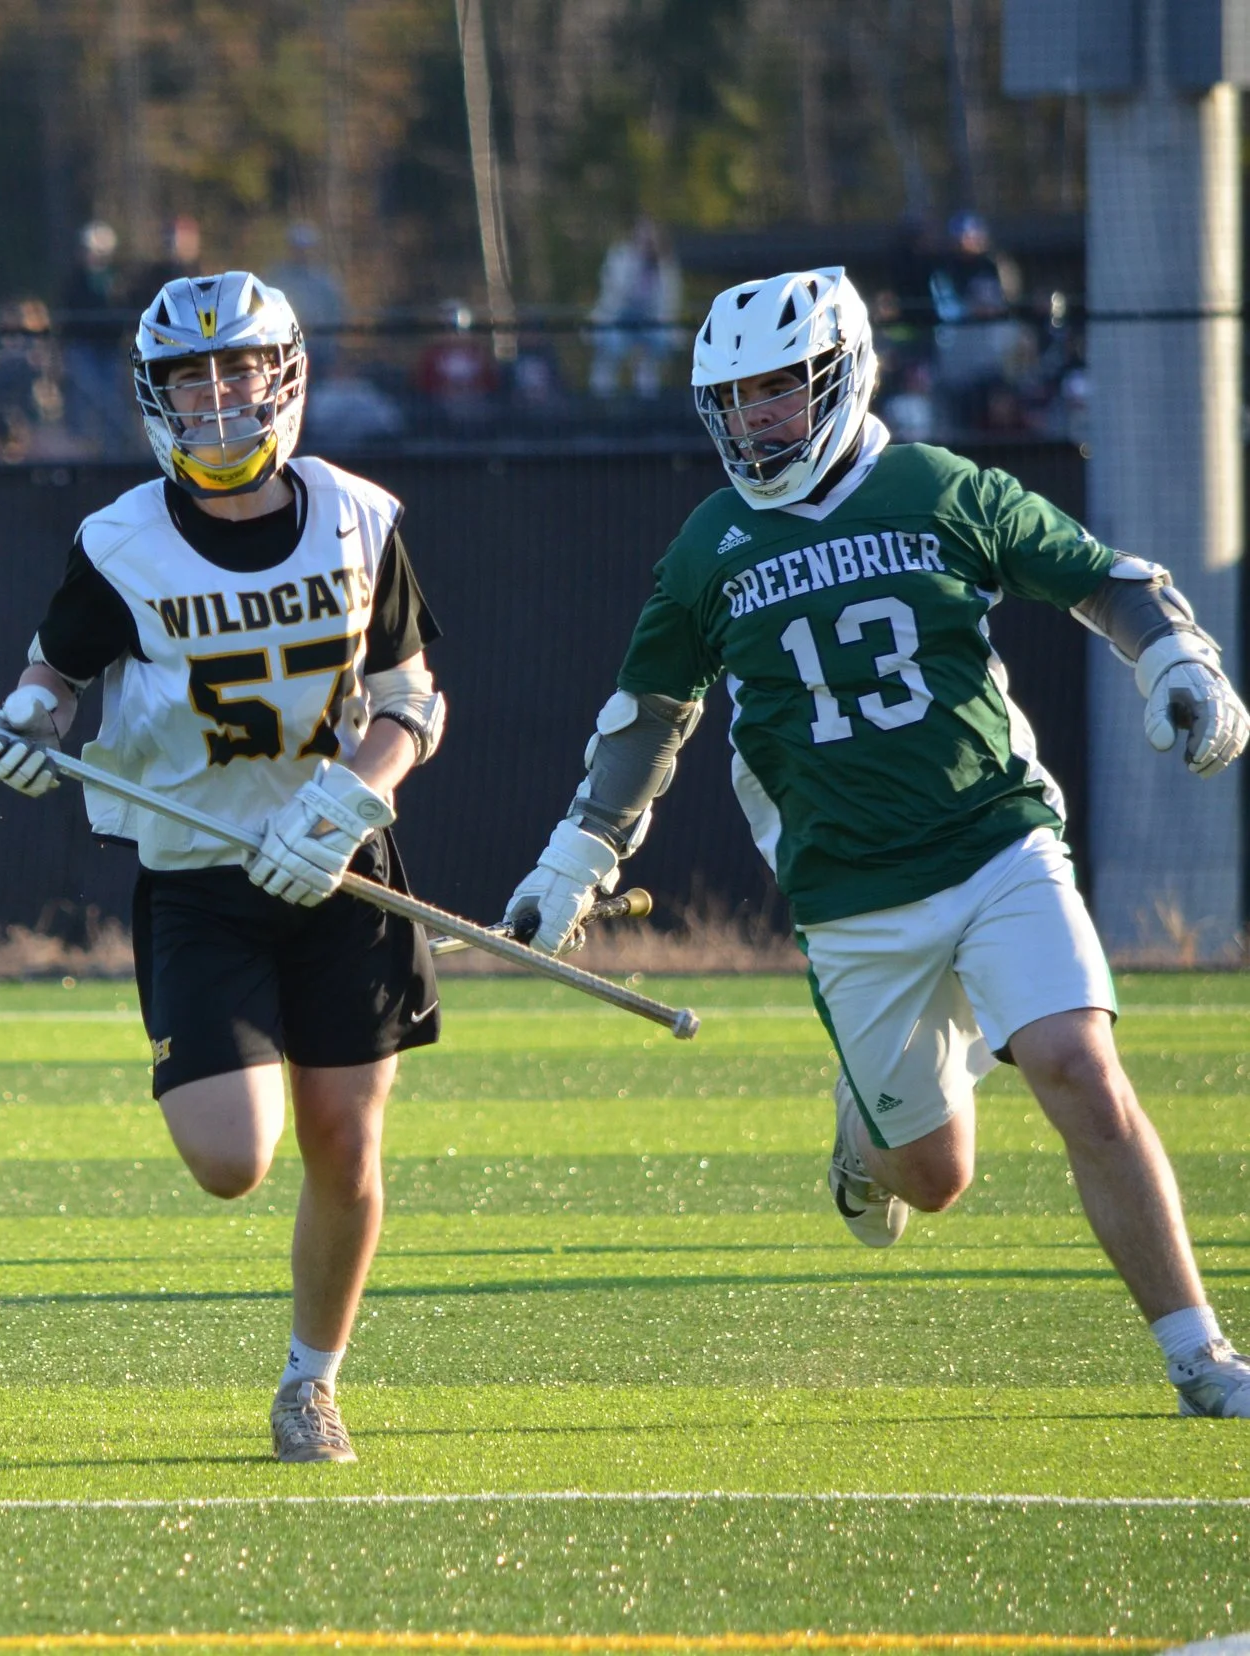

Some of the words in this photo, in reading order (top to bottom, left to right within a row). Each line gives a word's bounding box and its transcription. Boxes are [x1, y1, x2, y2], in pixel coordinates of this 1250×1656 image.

[717, 534, 752, 554] adidas
[722, 531, 945, 619] GREENBRIER
[146, 566, 371, 639] WILDCATS
[186, 630, 362, 767] 57
[780, 597, 934, 743] 13
